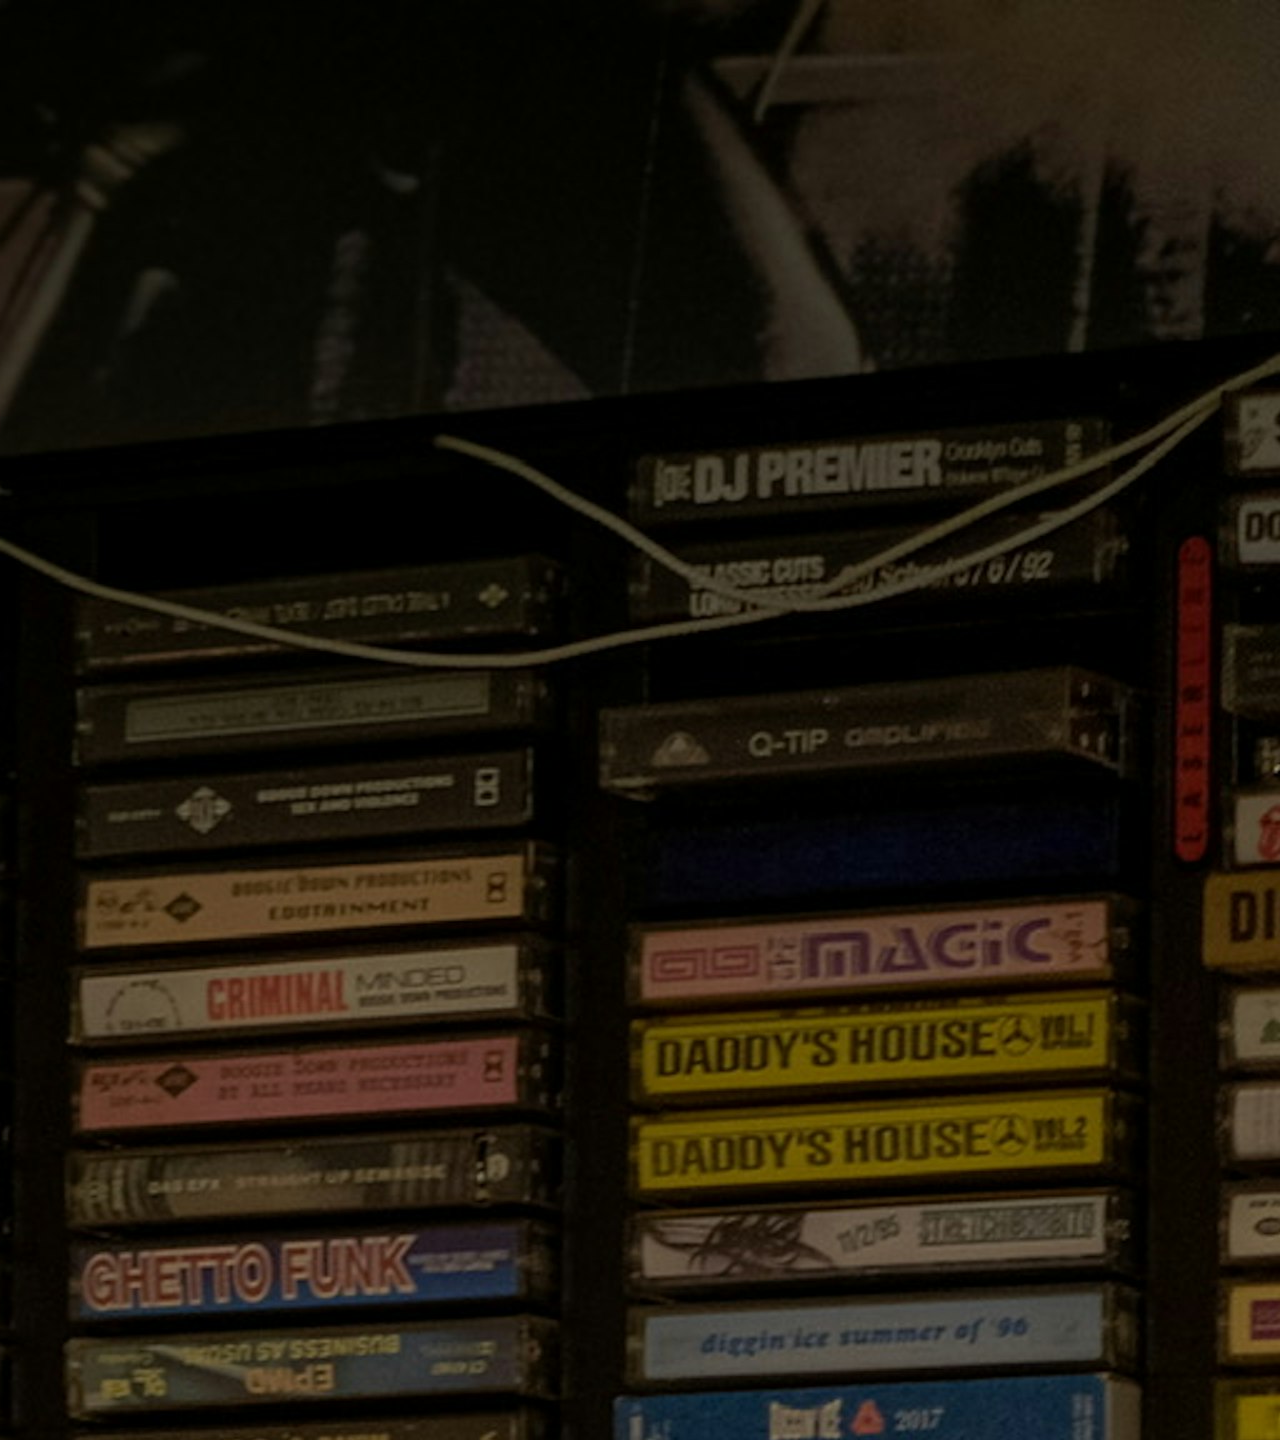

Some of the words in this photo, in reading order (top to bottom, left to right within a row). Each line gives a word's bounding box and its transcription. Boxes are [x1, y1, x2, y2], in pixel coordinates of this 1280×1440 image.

[692, 456, 749, 504] DJ
[756, 438, 942, 499] PREMIER
[748, 727, 830, 758] Q-TIP
[206, 969, 347, 1021] CRIMINAL
[355, 966, 465, 990] MINDED
[651, 1129, 834, 1177] DADDY'S
[844, 1118, 992, 1165] HOUSE
[82, 1240, 276, 1313] GHETTO
[278, 1233, 420, 1299] FUNK
[892, 1408, 945, 1432] 2017
